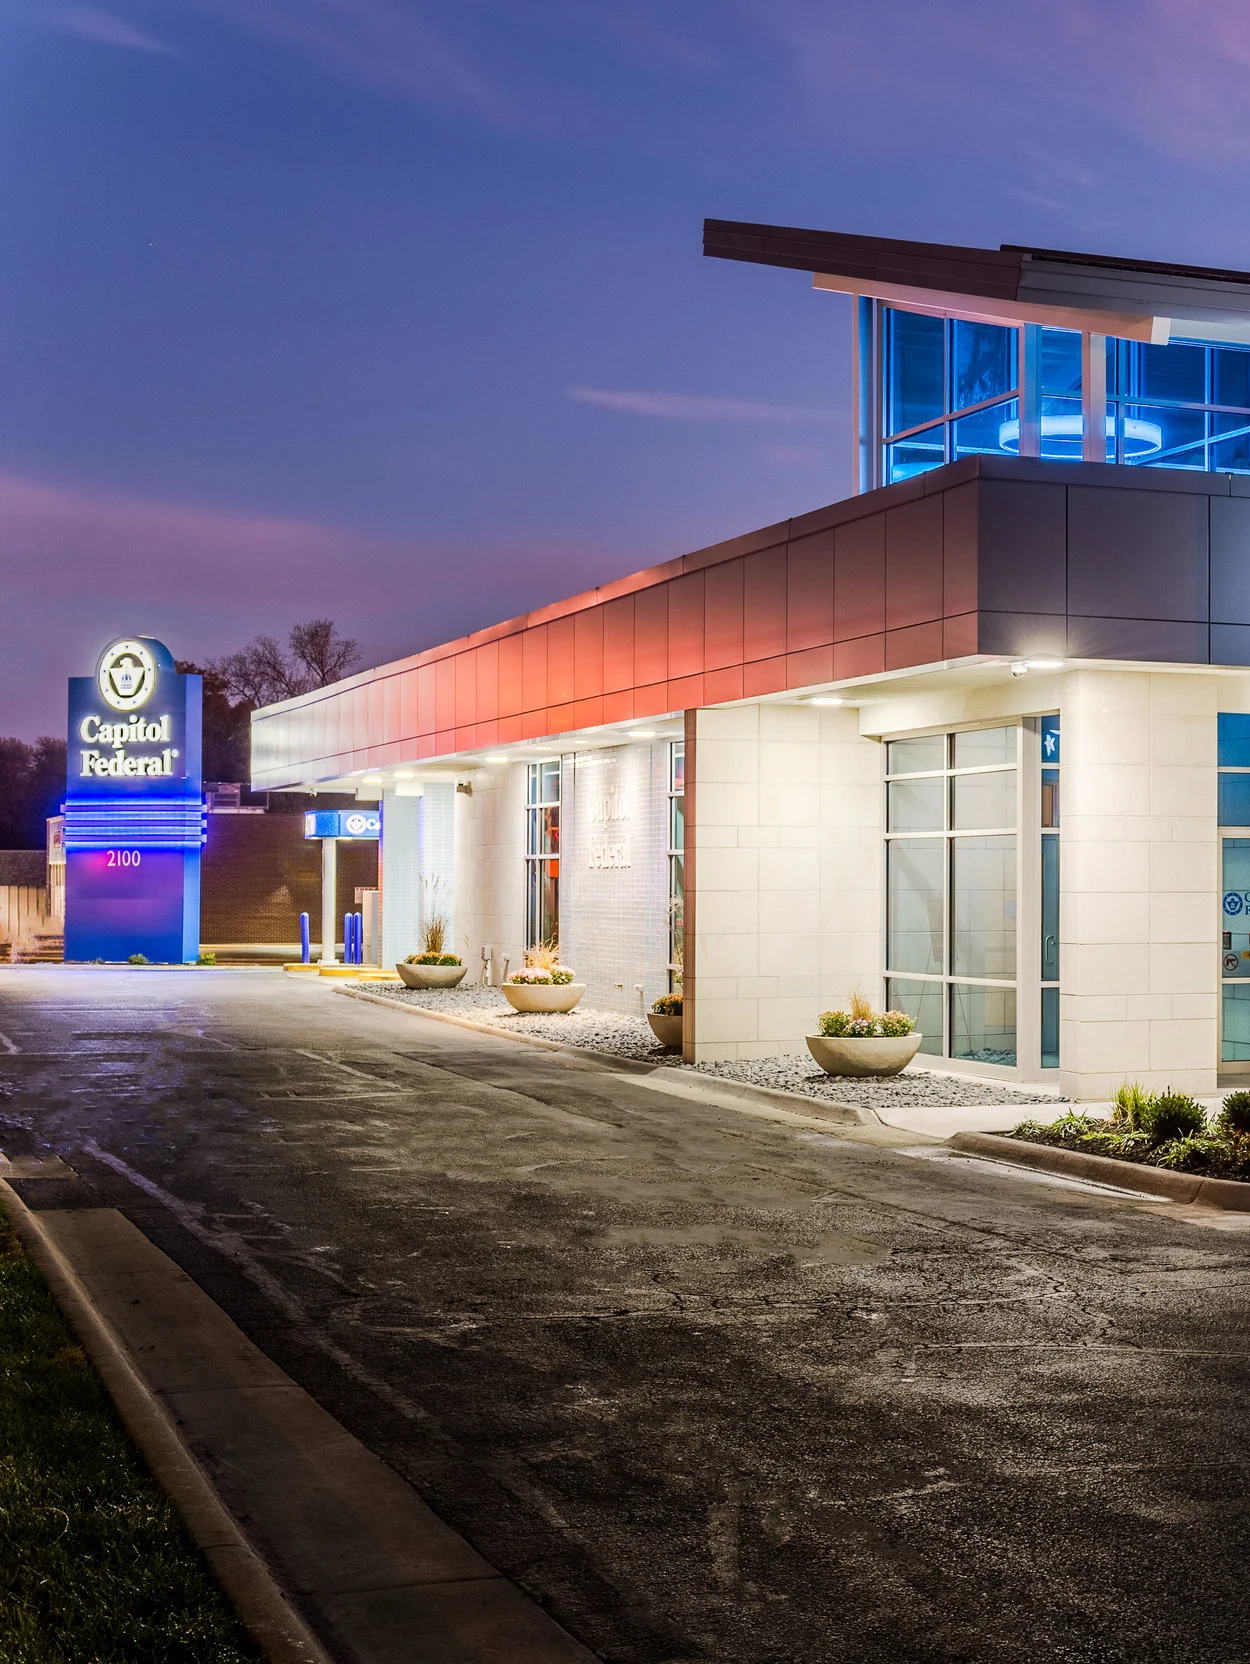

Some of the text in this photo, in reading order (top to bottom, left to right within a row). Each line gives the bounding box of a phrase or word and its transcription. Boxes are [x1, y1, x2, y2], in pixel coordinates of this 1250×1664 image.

[80, 714, 171, 748] Capitol
[80, 749, 174, 777] Federal
[107, 850, 141, 867] 2100
